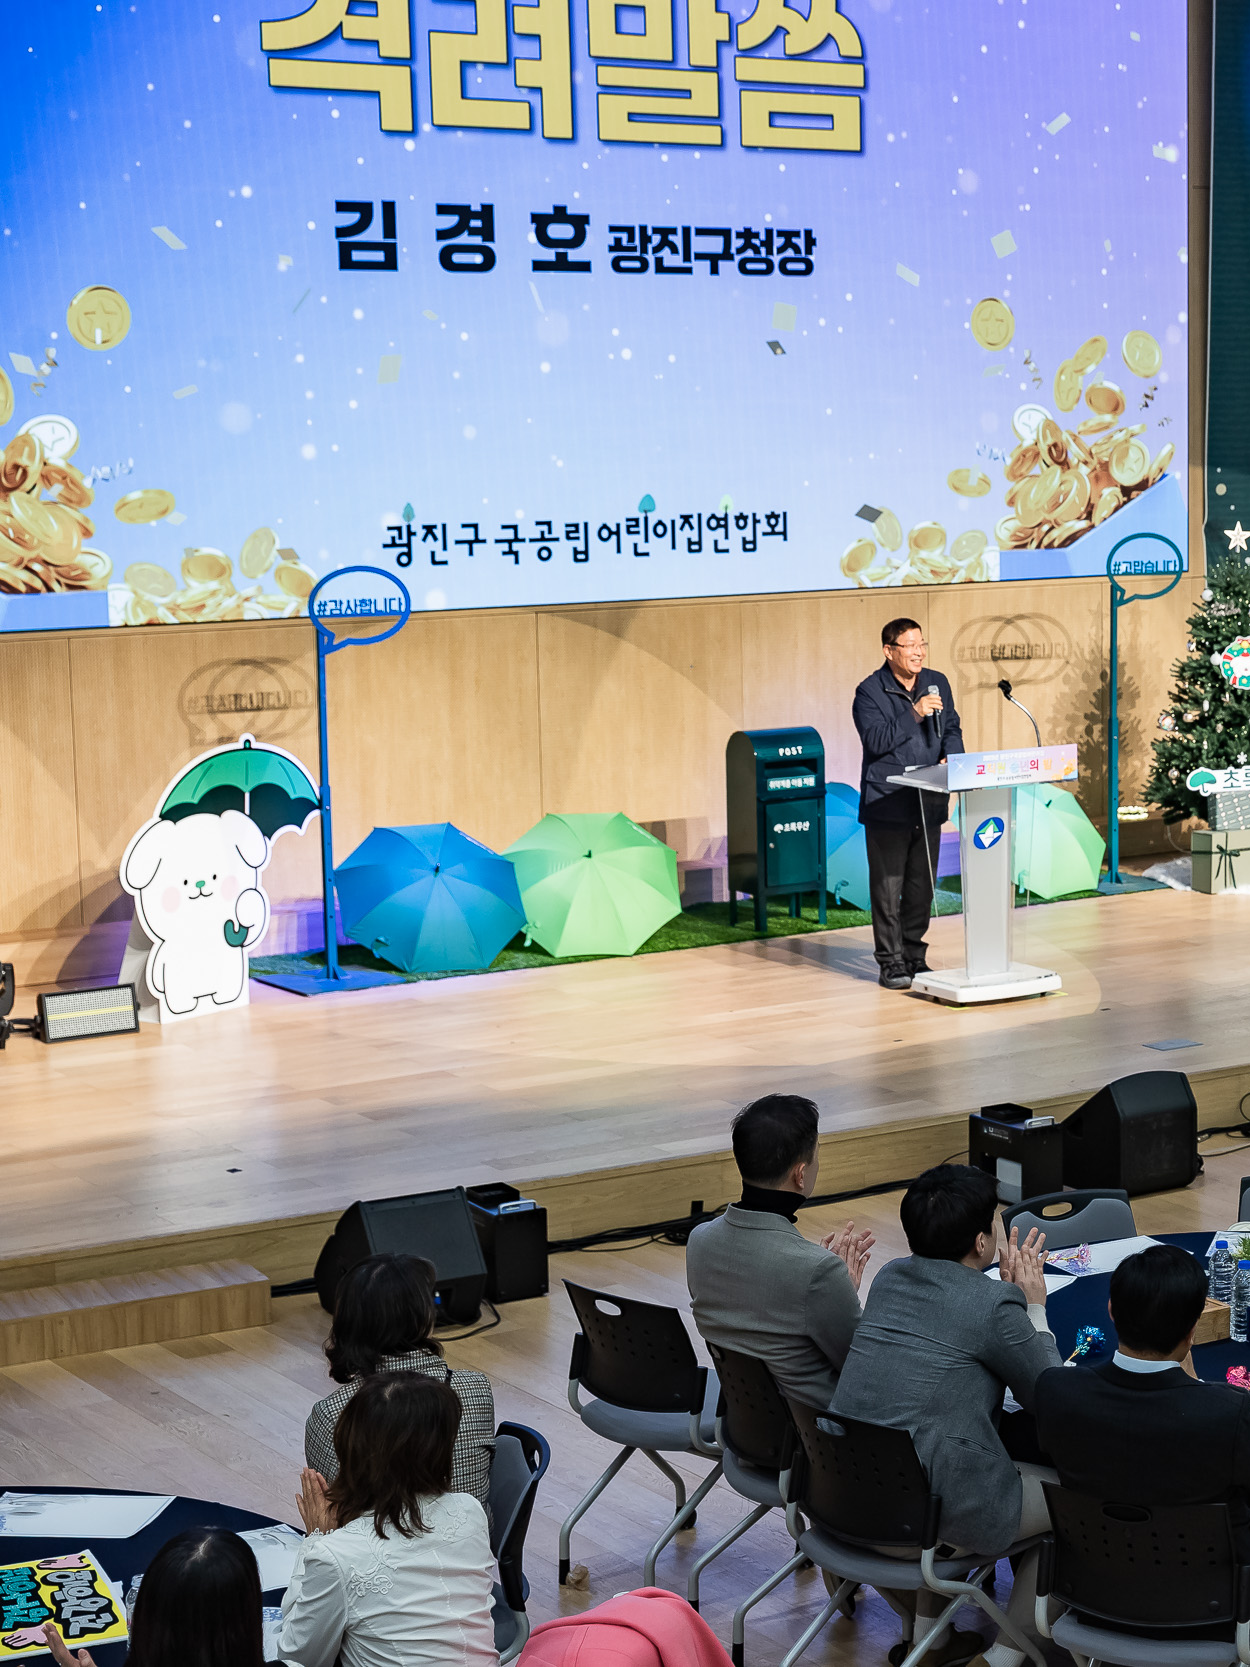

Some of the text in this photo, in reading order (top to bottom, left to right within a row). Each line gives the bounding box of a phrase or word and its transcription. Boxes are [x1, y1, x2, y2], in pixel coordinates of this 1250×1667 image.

[260, 0, 866, 152] 격려말씀
[607, 224, 818, 277] 광진구청장
[1112, 559, 1178, 576] #고맙습니다
[317, 597, 403, 617] #감사합니다
[778, 745, 803, 757] POST
